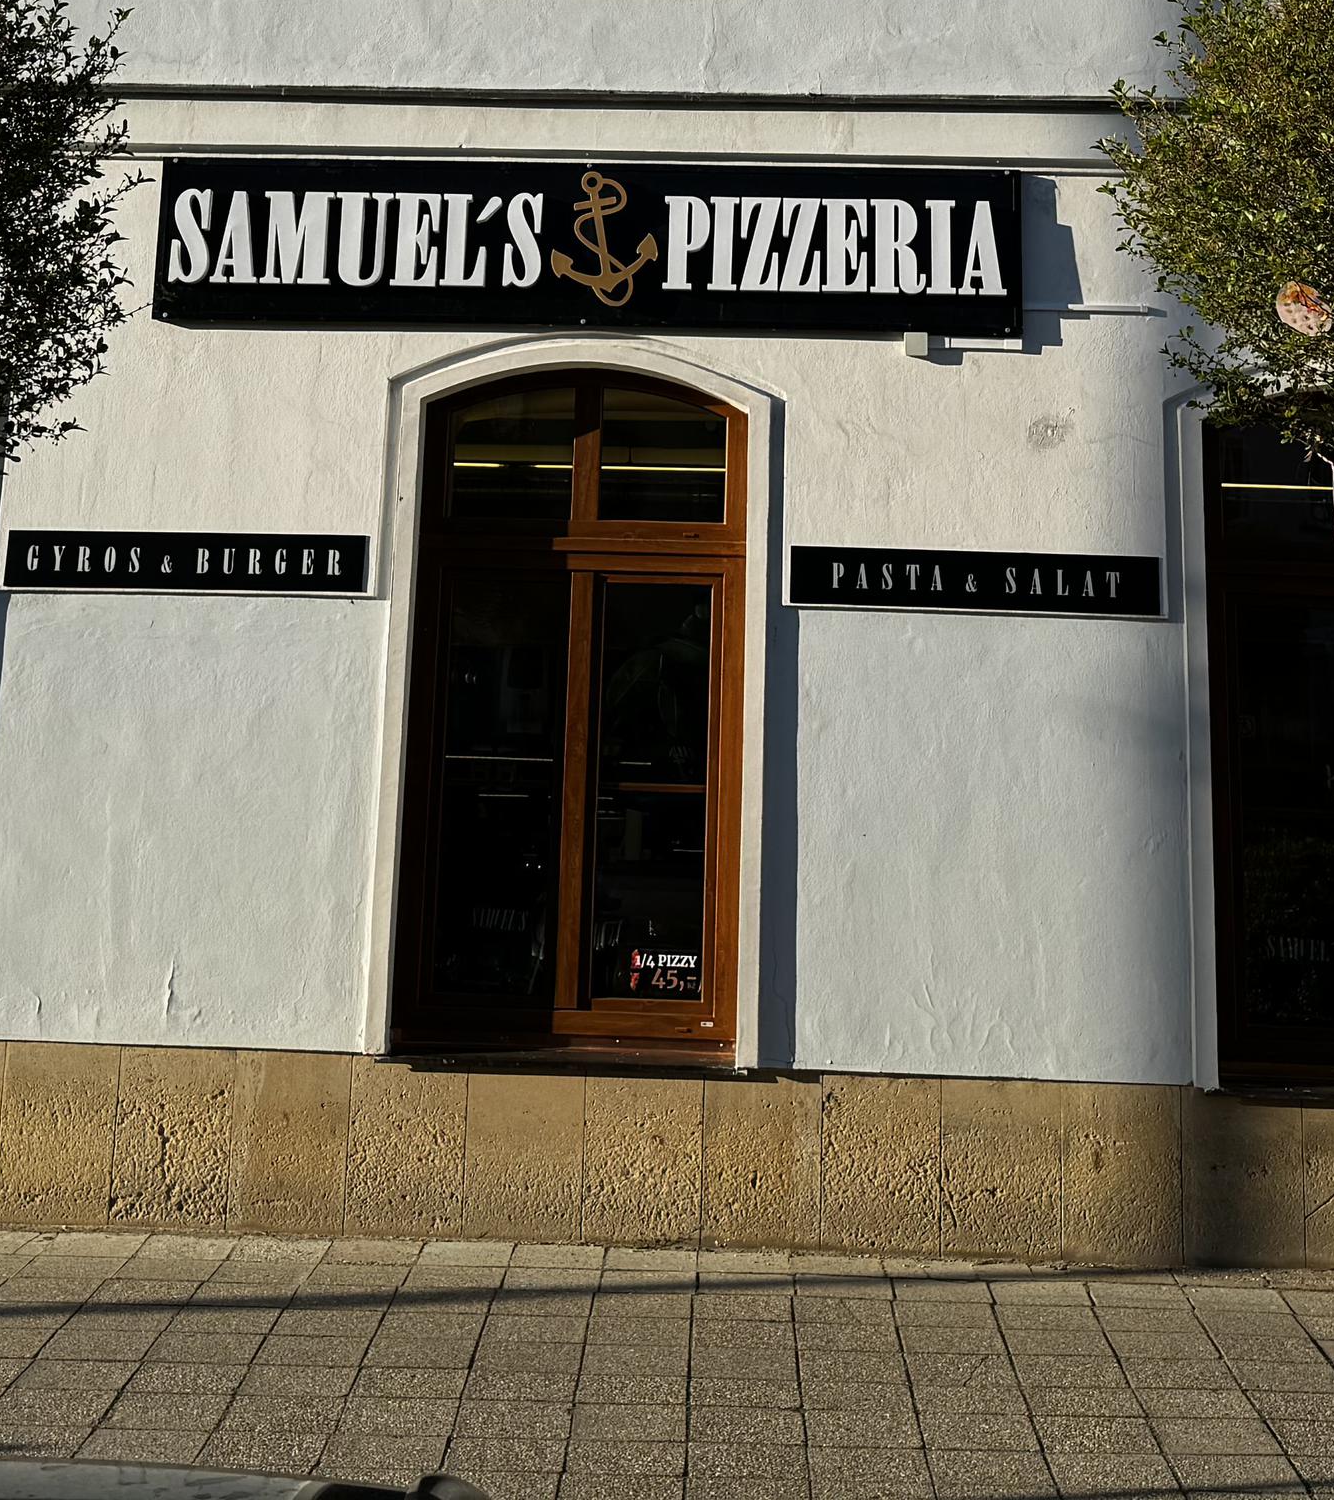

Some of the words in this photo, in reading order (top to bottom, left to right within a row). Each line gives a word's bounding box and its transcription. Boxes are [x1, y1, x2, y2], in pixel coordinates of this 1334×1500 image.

[661, 195, 1008, 296] PIZZERIA
[26, 544, 141, 573] GYROS
[160, 555, 173, 574] &
[196, 547, 342, 576] BURGER
[832, 562, 943, 591] PASTA
[965, 573, 978, 593] &
[1005, 567, 1121, 598] SALAT
[634, 954, 655, 968] 1/4
[658, 954, 698, 968] PIZZY
